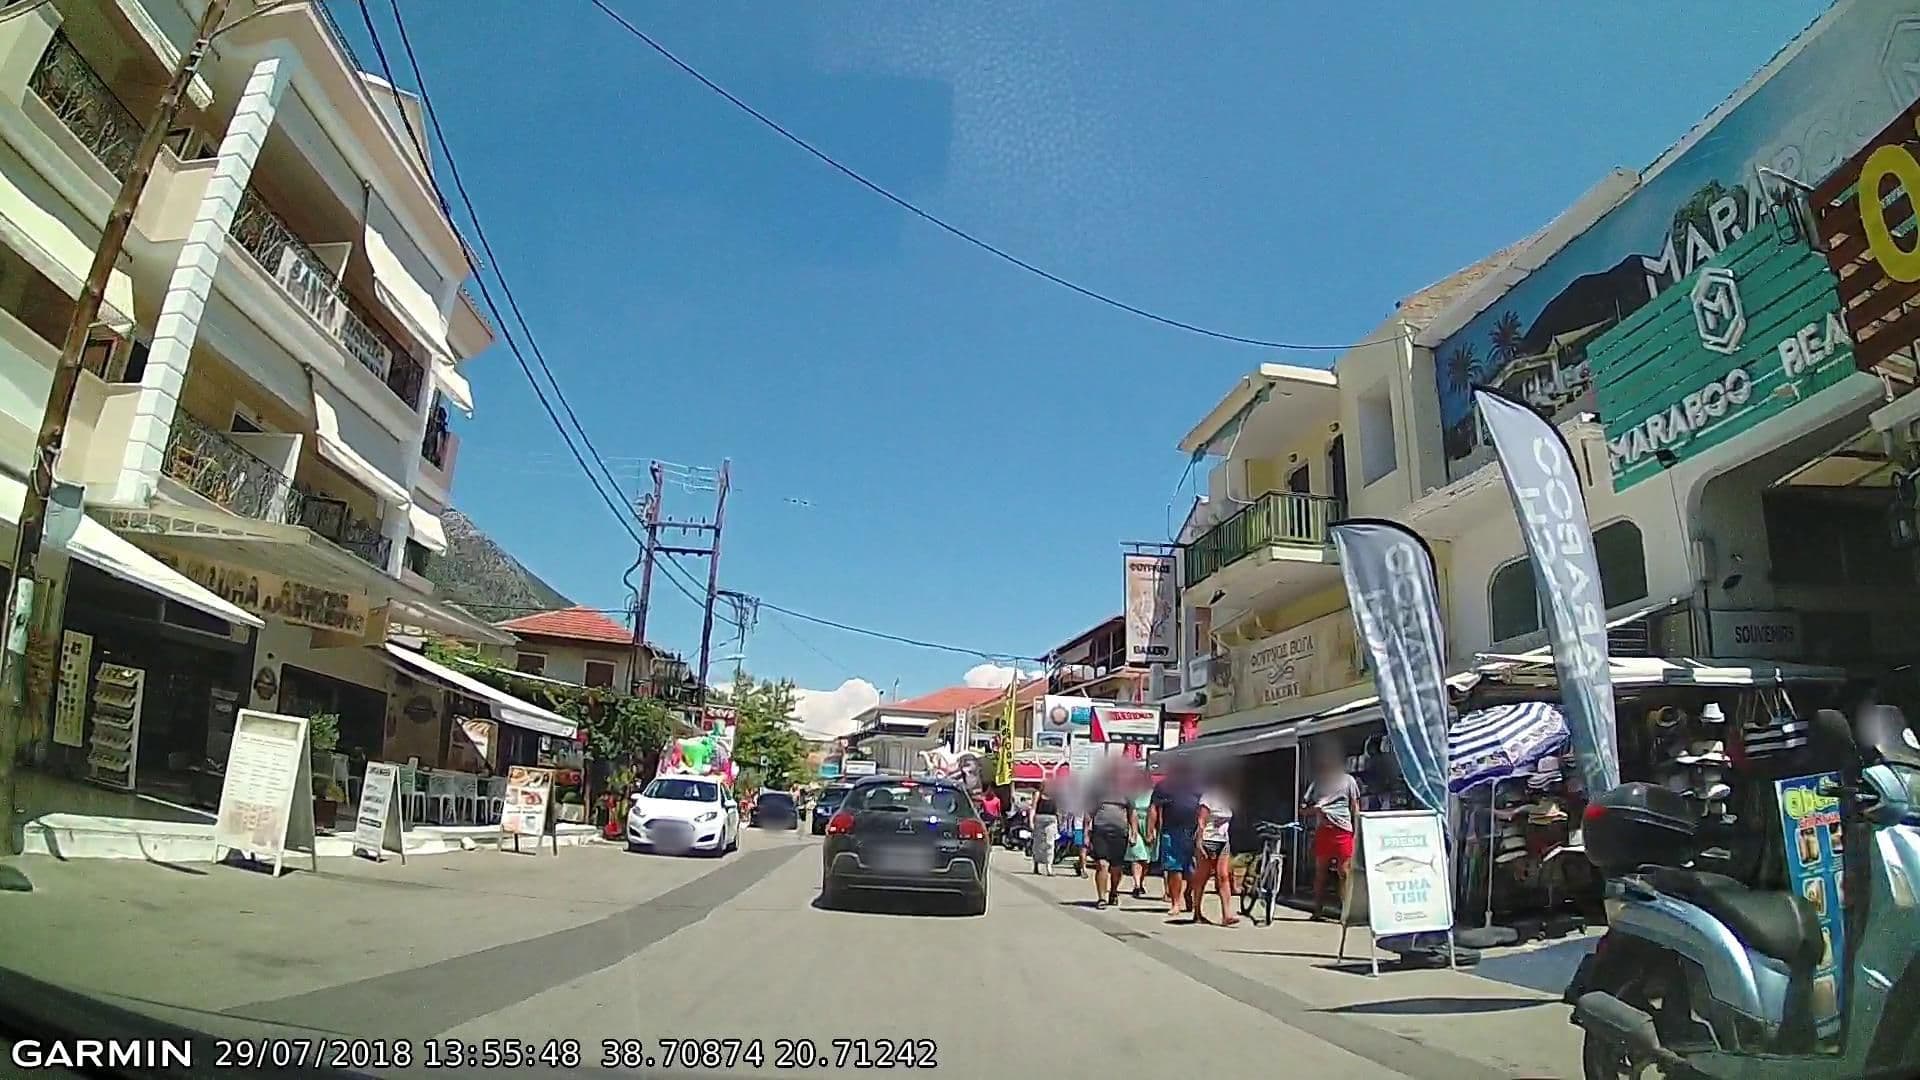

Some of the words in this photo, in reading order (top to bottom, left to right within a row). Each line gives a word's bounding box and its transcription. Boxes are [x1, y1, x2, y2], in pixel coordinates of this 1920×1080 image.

[1608, 368, 1751, 469] MARABOO
[1778, 307, 1850, 377] BEA
[1133, 645, 1170, 656] BAKERY
[1384, 836, 1425, 848] FRESH
[1385, 879, 1432, 892] TUNA
[1392, 892, 1428, 905] FISH
